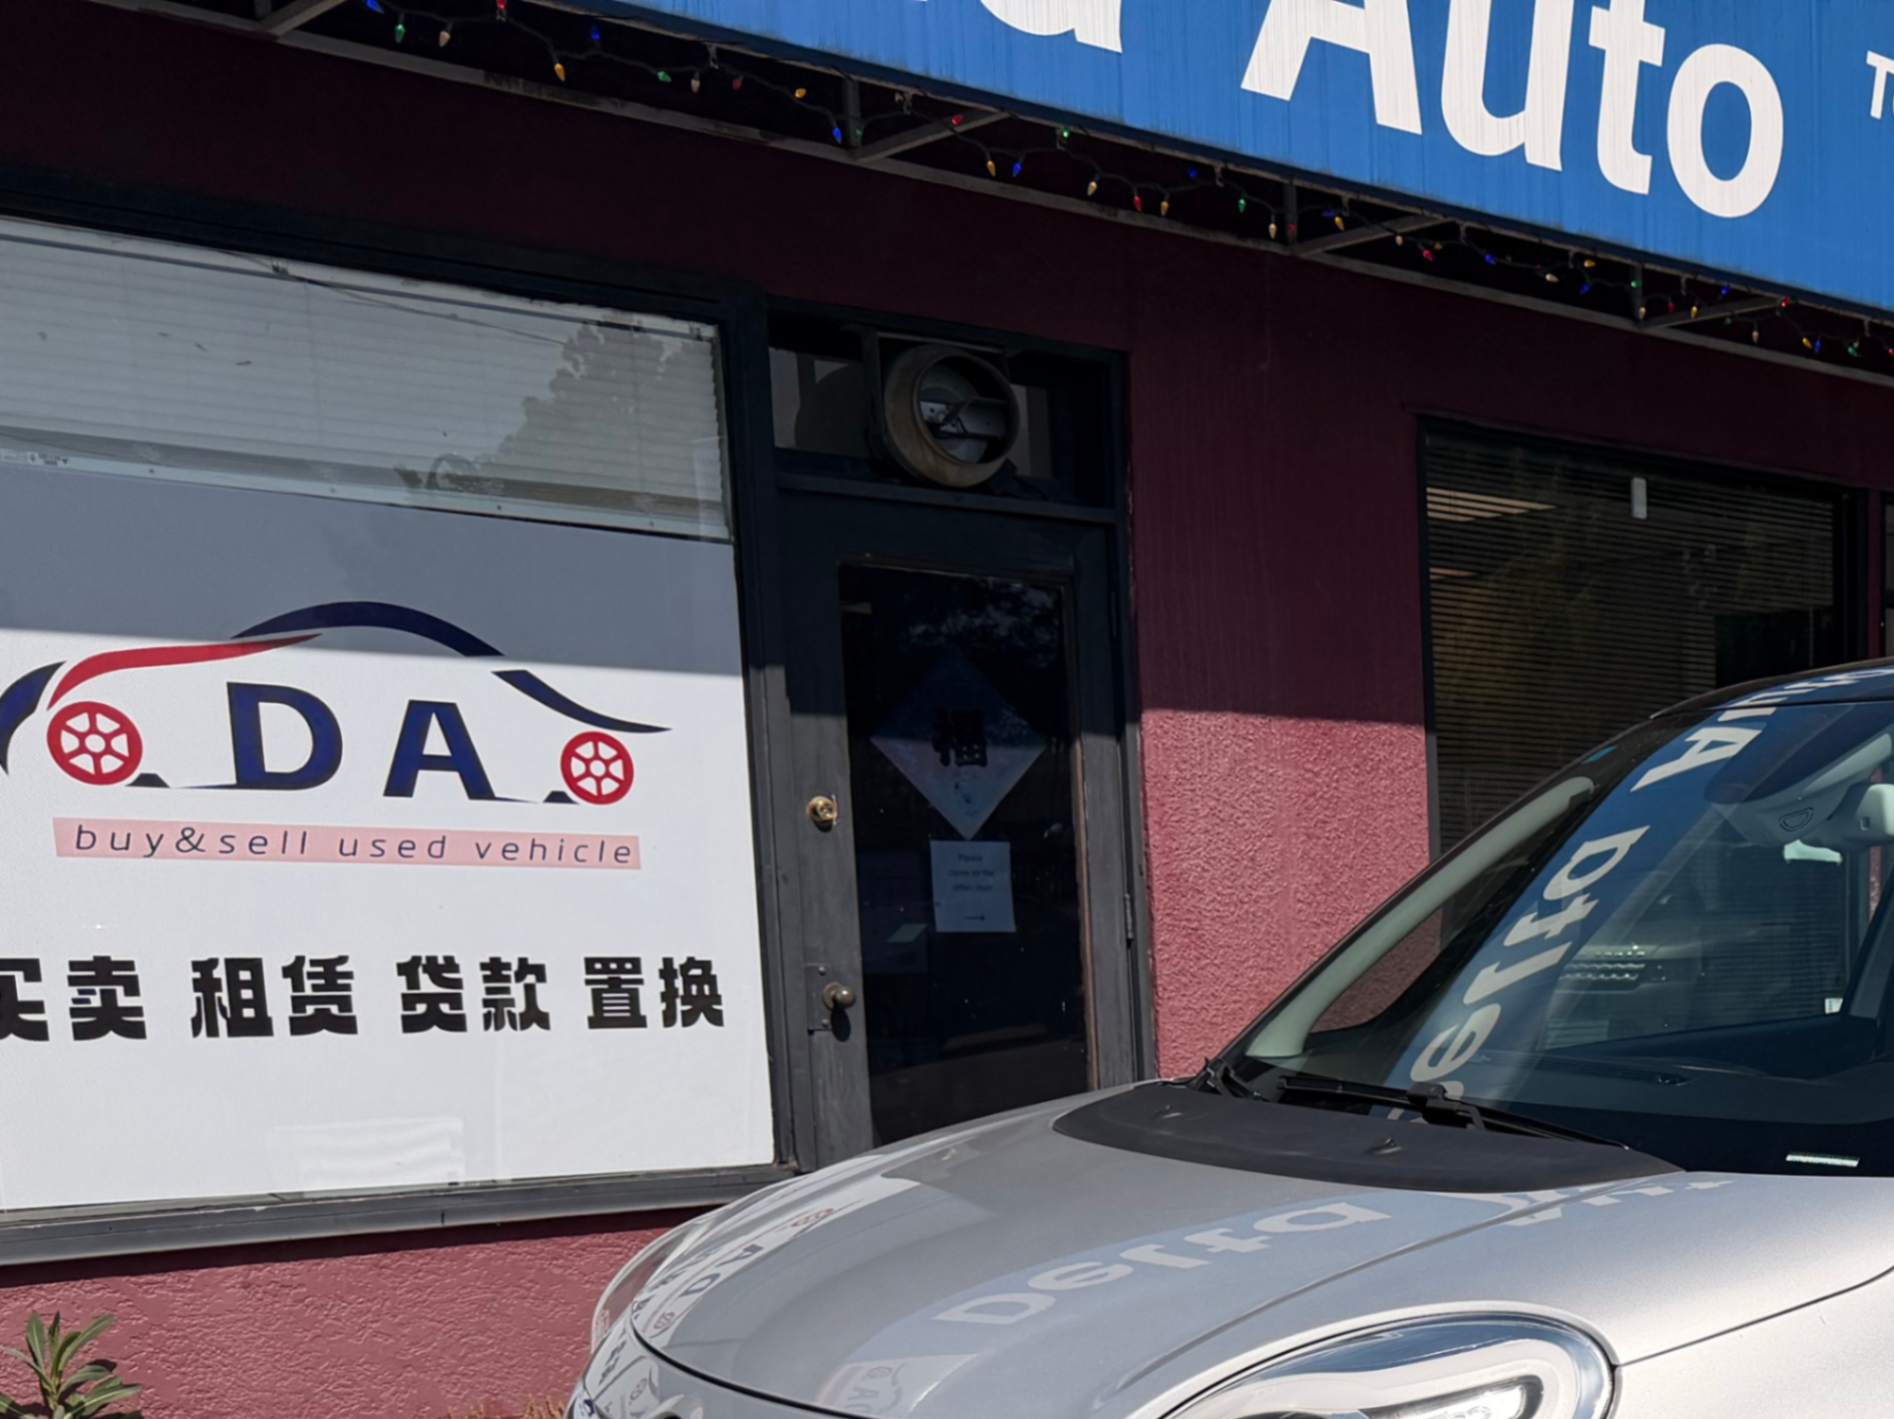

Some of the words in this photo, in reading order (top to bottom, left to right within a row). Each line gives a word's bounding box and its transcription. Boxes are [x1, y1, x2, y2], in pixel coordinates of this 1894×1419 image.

[75, 824, 308, 858] buy&sell
[338, 834, 447, 859] used
[475, 836, 632, 865] vehicle
[0, 955, 147, 1042] 买卖
[191, 955, 359, 1038] 租赁
[397, 955, 551, 1034] 贷款
[584, 956, 724, 1029] 置换
